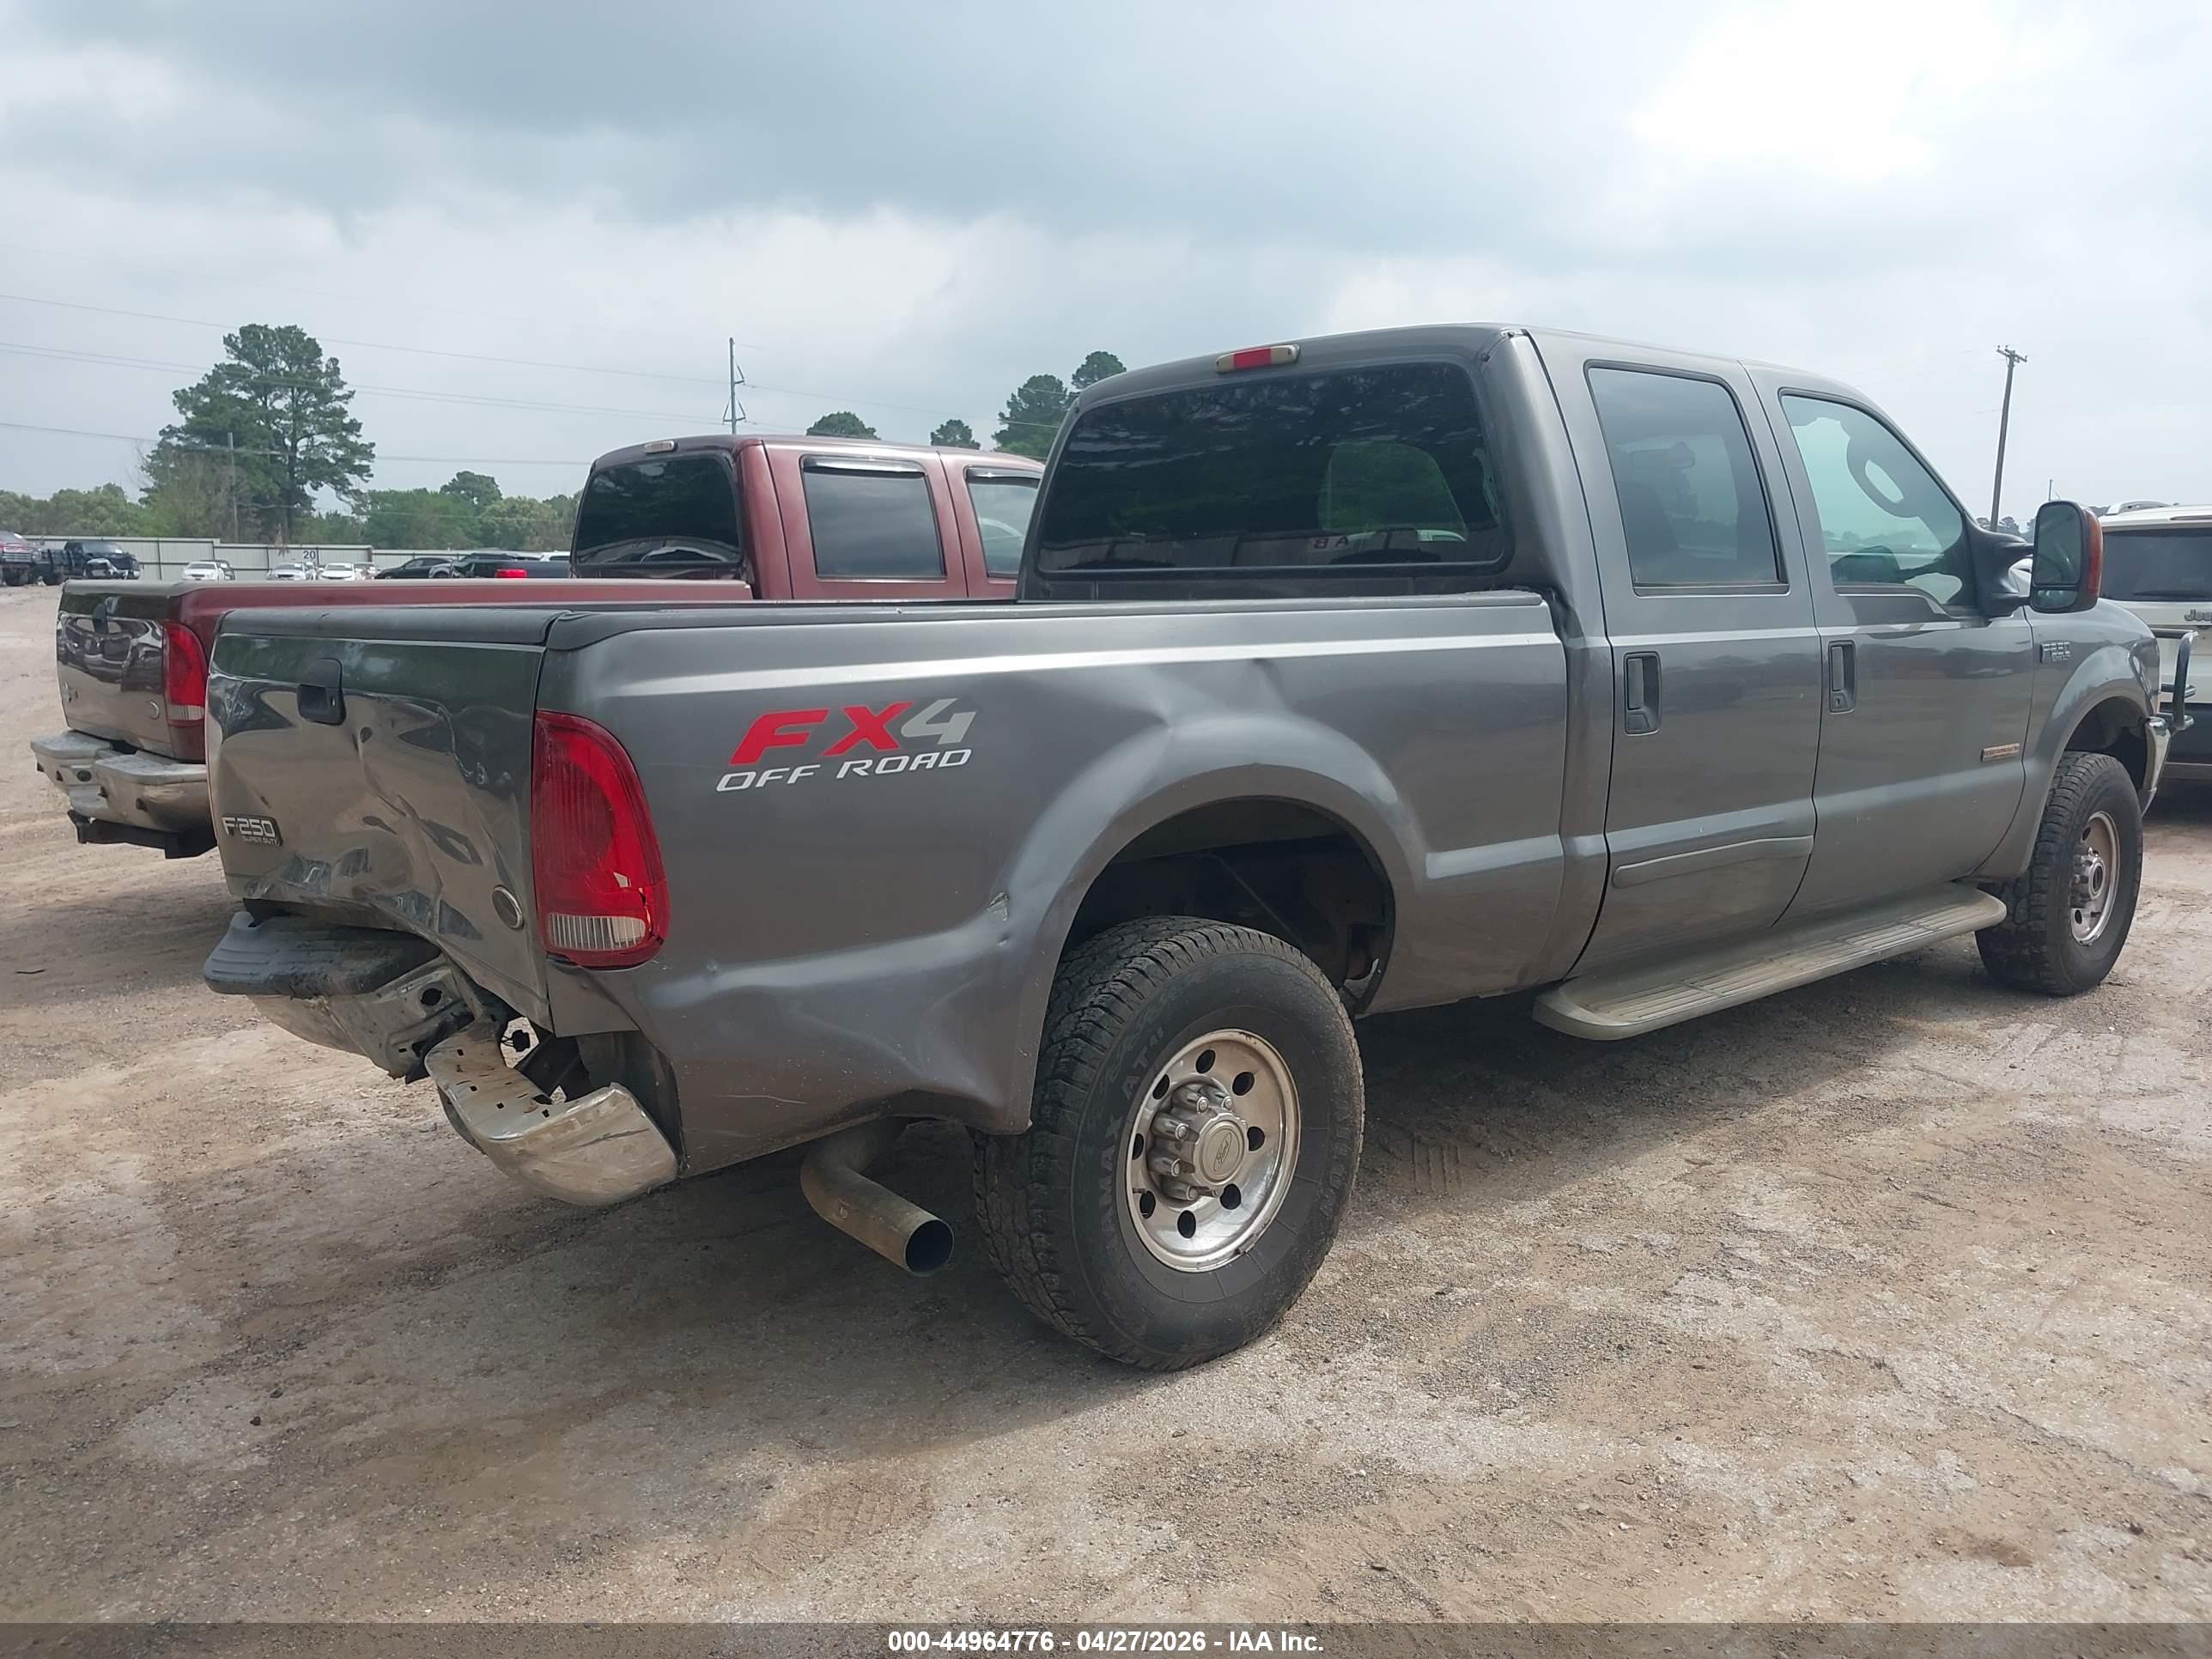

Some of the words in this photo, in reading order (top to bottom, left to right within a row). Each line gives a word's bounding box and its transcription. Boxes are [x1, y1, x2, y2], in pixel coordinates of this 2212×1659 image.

[302, 550, 316, 559] 20
[2184, 608, 2212, 623] Jee
[729, 698, 977, 766] FX4
[716, 765, 821, 792] OFF
[836, 750, 972, 778] ROAD
